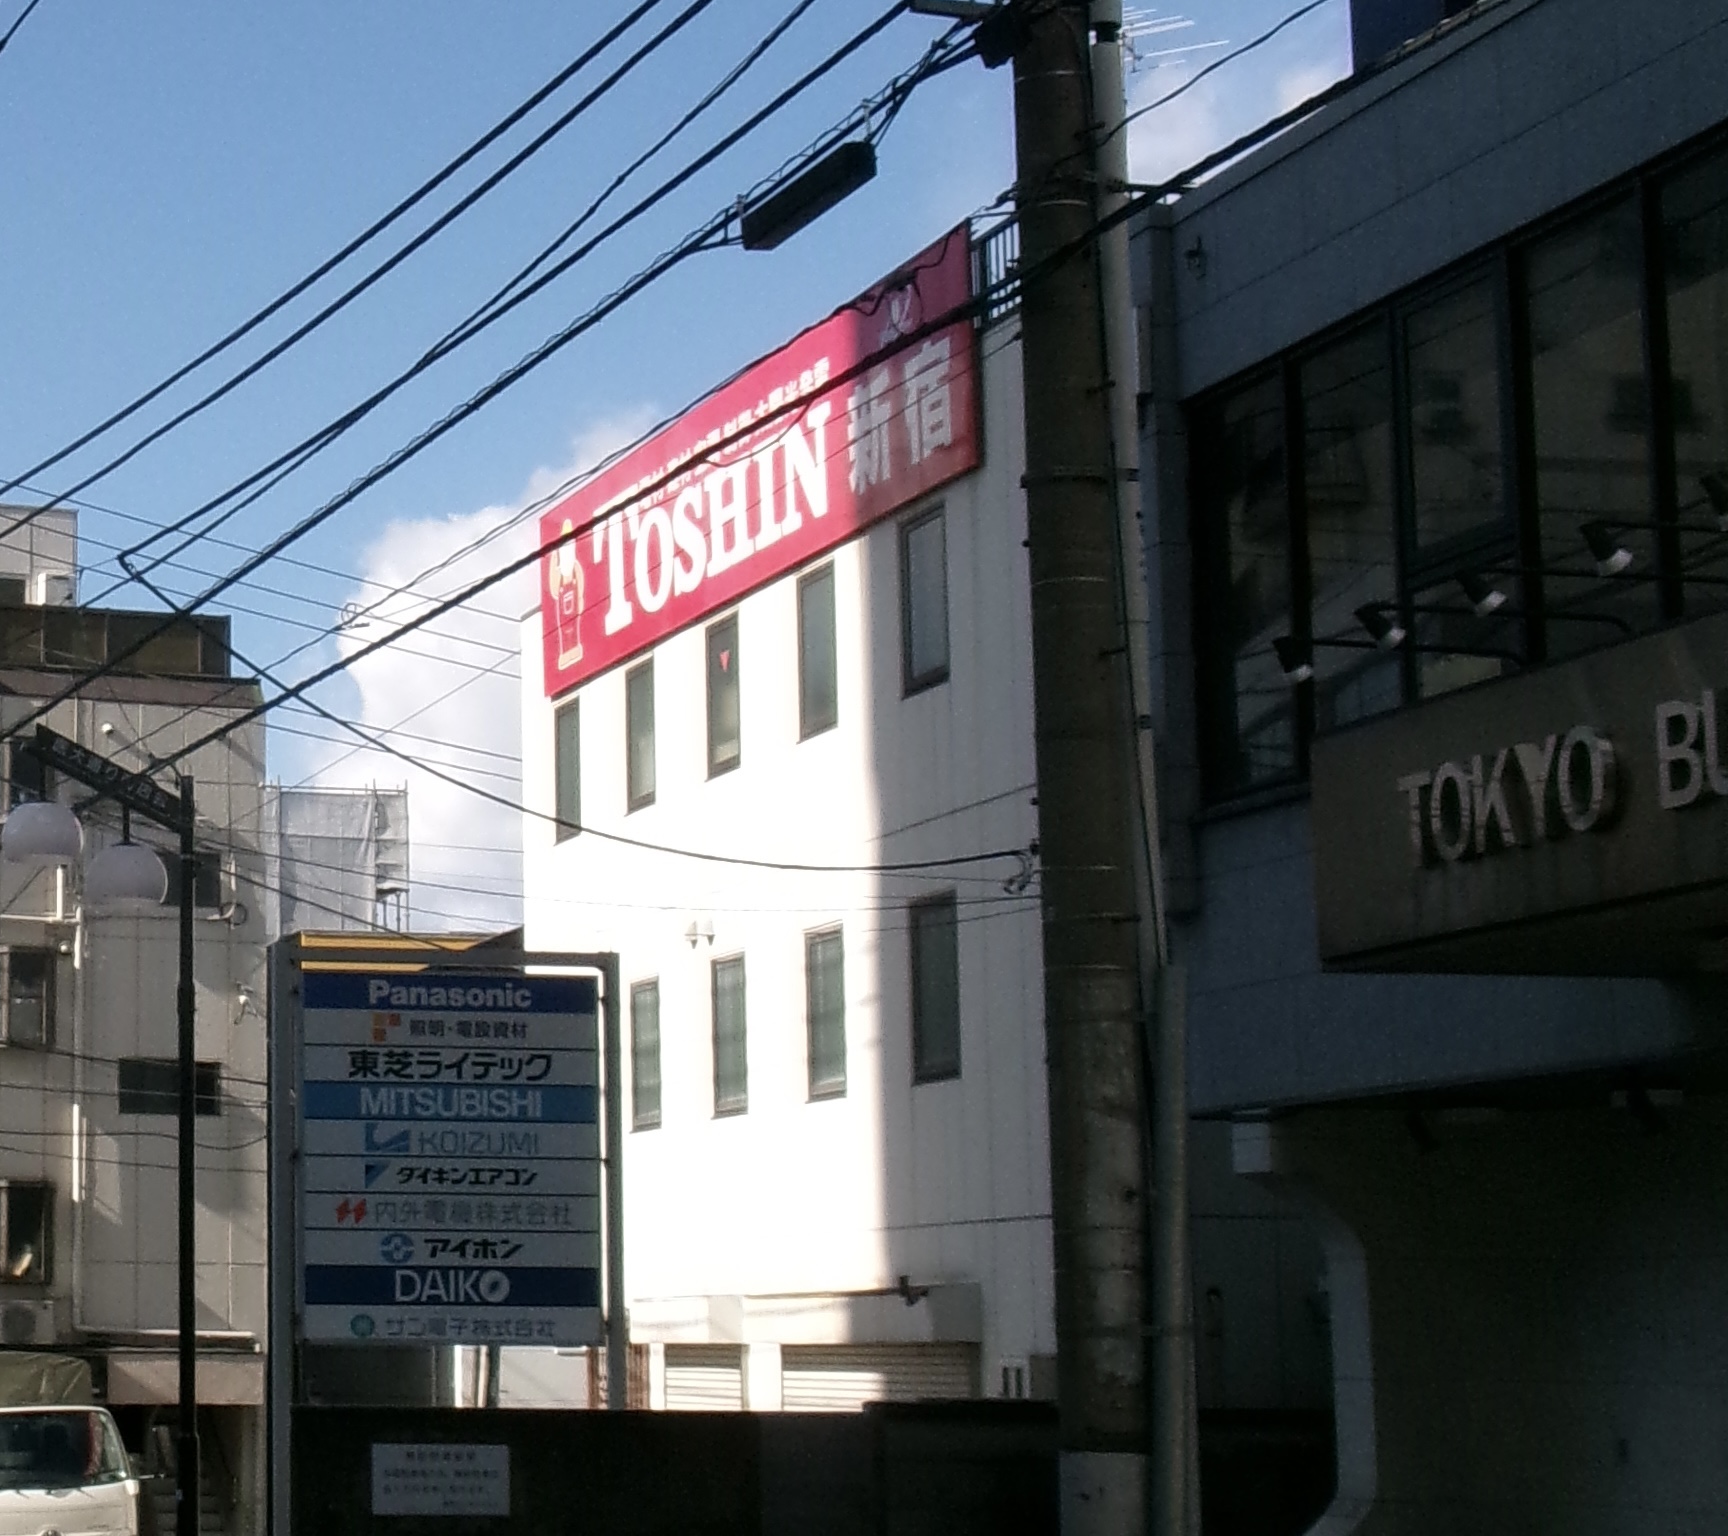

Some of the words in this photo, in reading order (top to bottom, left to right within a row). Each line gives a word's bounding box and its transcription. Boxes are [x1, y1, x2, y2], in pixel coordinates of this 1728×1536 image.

[847, 337, 955, 495] 新宿
[591, 400, 833, 637] TOSHIN
[1397, 726, 1614, 866] TOKYO
[368, 978, 533, 1008] Panasonic
[347, 1049, 553, 1081] 東芝ライテック
[360, 1087, 543, 1119] MITSUBISHI
[418, 1129, 540, 1155] KOIZUMI
[396, 1166, 538, 1186] ダイキンエアコン
[375, 1201, 572, 1226] 内外電機株式会社
[423, 1238, 524, 1259] アイホン
[394, 1268, 511, 1304] DAIKO
